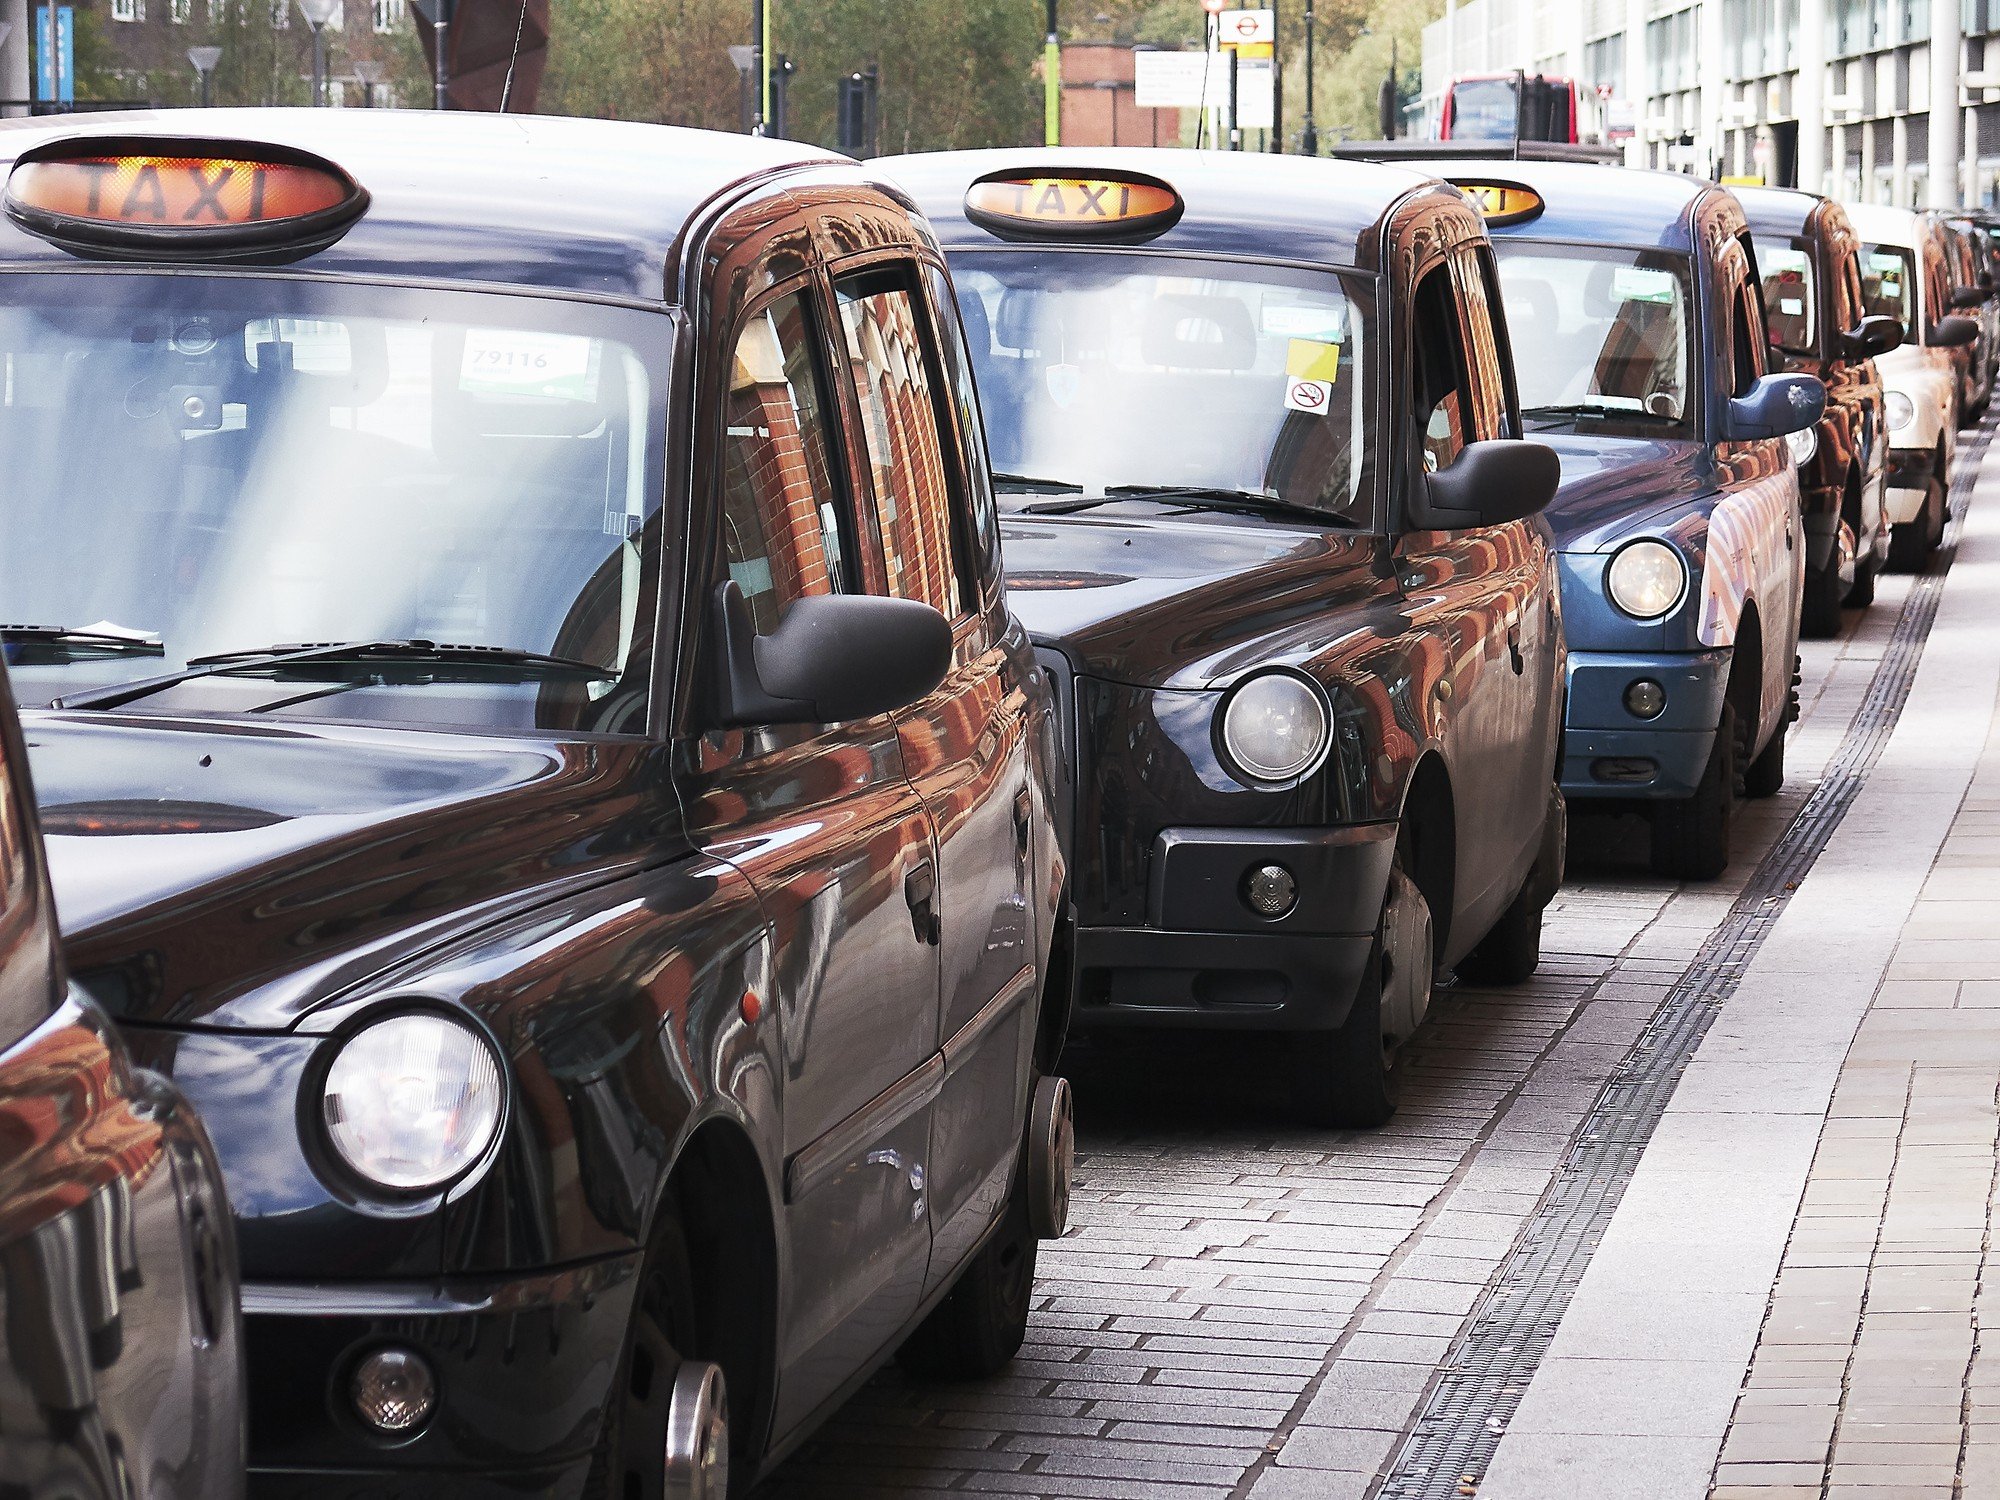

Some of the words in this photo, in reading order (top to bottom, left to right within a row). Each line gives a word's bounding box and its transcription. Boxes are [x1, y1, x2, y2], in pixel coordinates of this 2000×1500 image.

[79, 162, 266, 221] TAXI
[1008, 184, 1130, 216] TAXI
[1468, 188, 1506, 211] XI
[472, 349, 548, 369] 79116
